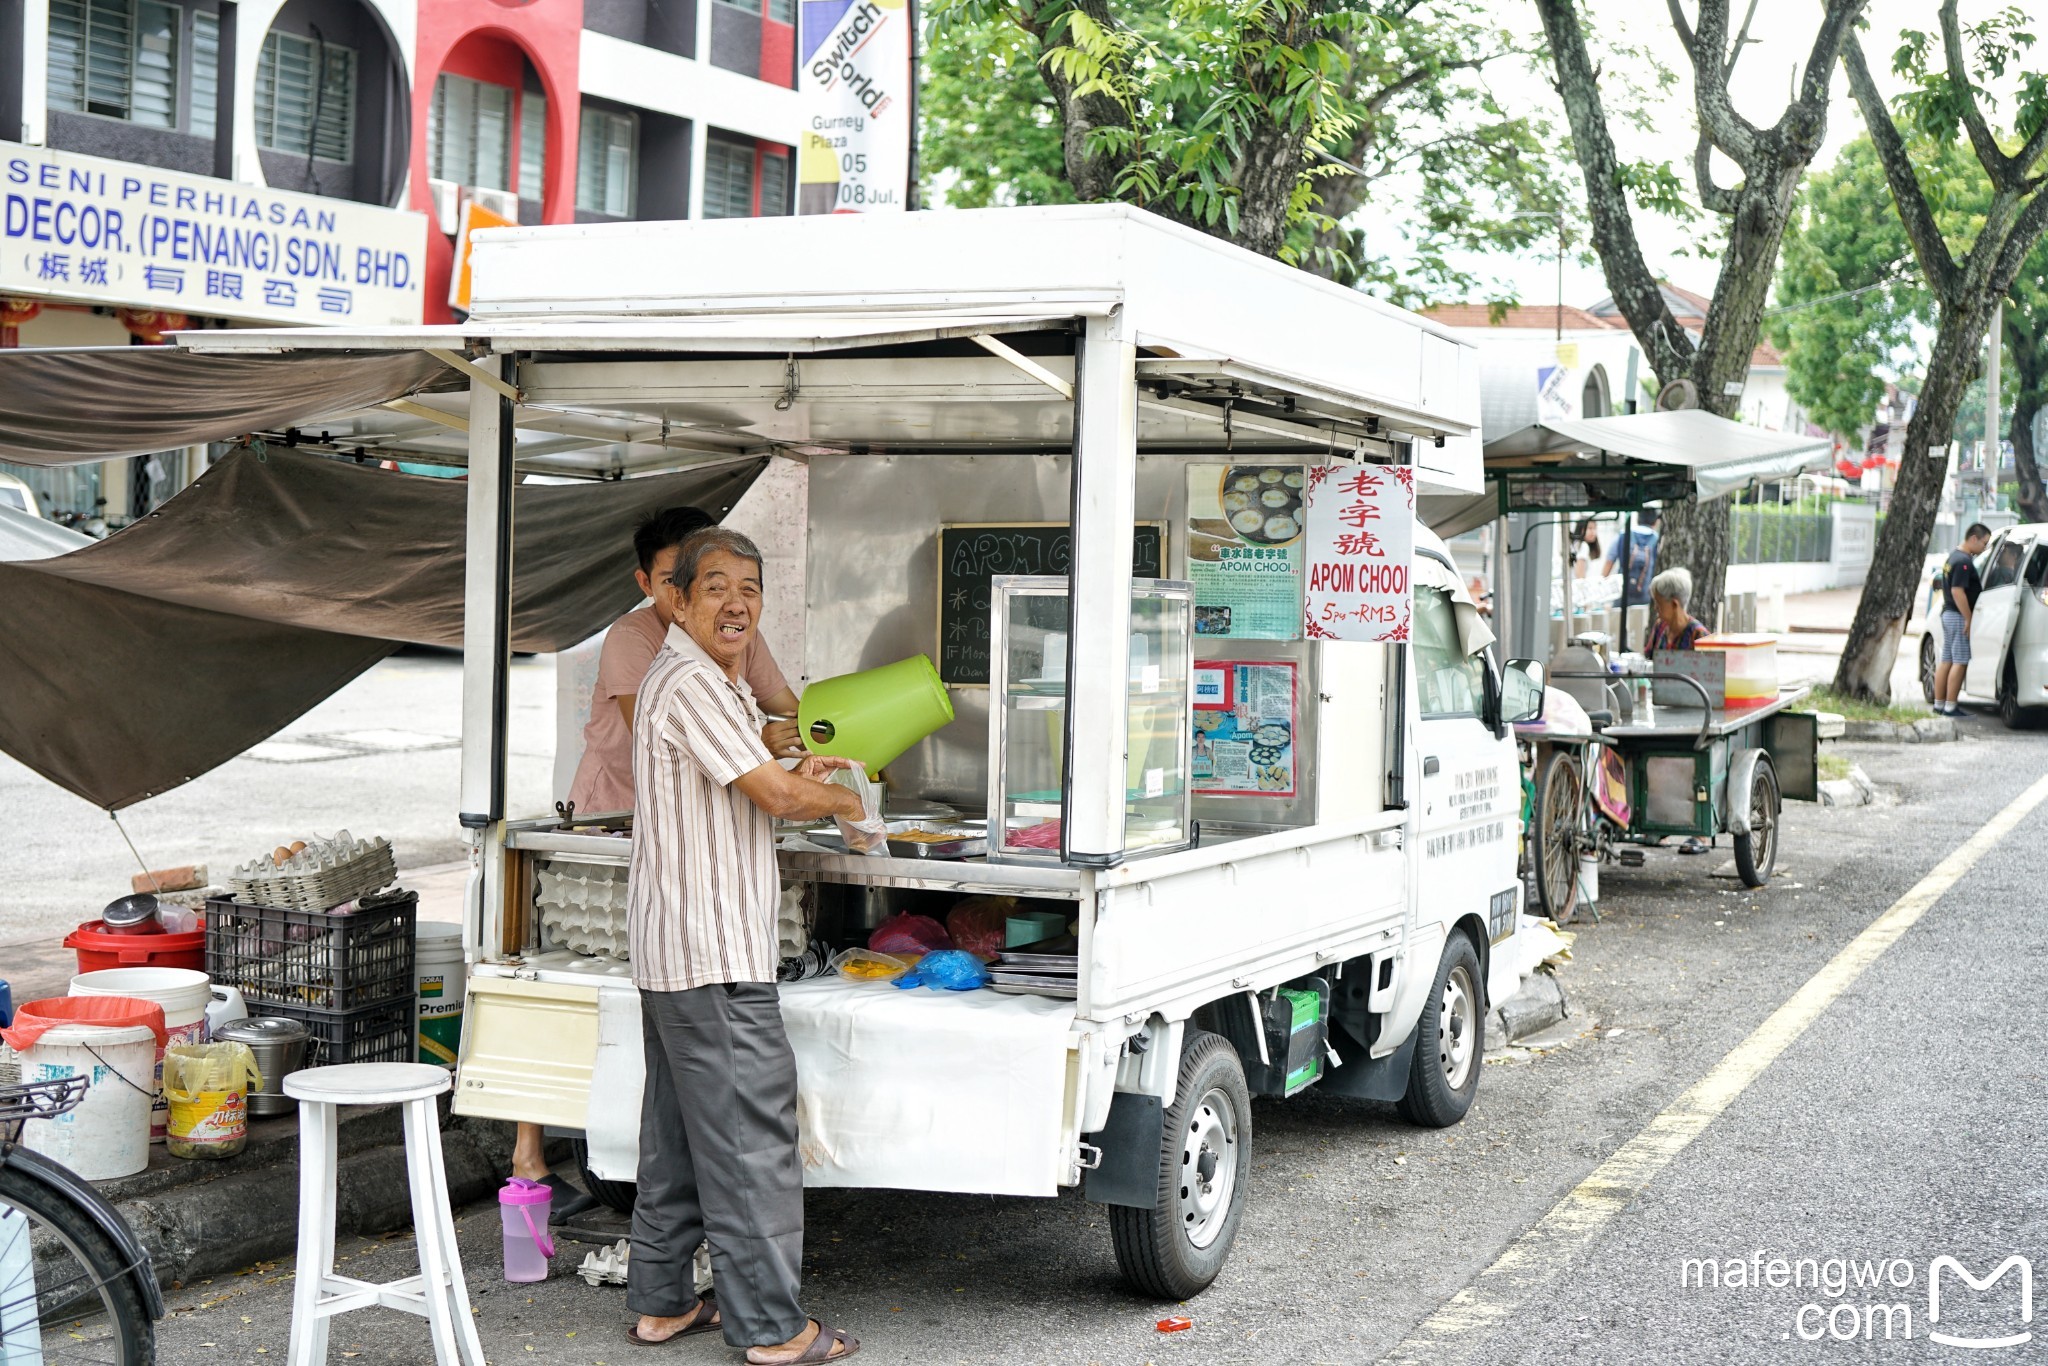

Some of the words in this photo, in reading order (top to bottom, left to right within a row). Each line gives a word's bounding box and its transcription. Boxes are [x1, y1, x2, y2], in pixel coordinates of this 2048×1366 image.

[812, 2, 881, 86] Switch
[811, 115, 865, 132] Gurney
[811, 134, 848, 149] Plaza
[842, 153, 867, 173] 05
[7, 158, 106, 197] SENI
[122, 176, 336, 233] PERHIASAN
[841, 184, 866, 204] 08
[868, 188, 899, 205] Jul.
[5, 194, 131, 253] DECOR.
[355, 246, 416, 291] BHD.
[1333, 470, 1385, 557] 老字號
[951, 533, 1042, 577] APOM
[1219, 561, 1252, 573] APOM
[1254, 562, 1291, 573] CHOOI
[1310, 563, 1355, 593] APOM
[1359, 564, 1408, 594] CHOOI
[420, 976, 442, 984] BORAL
